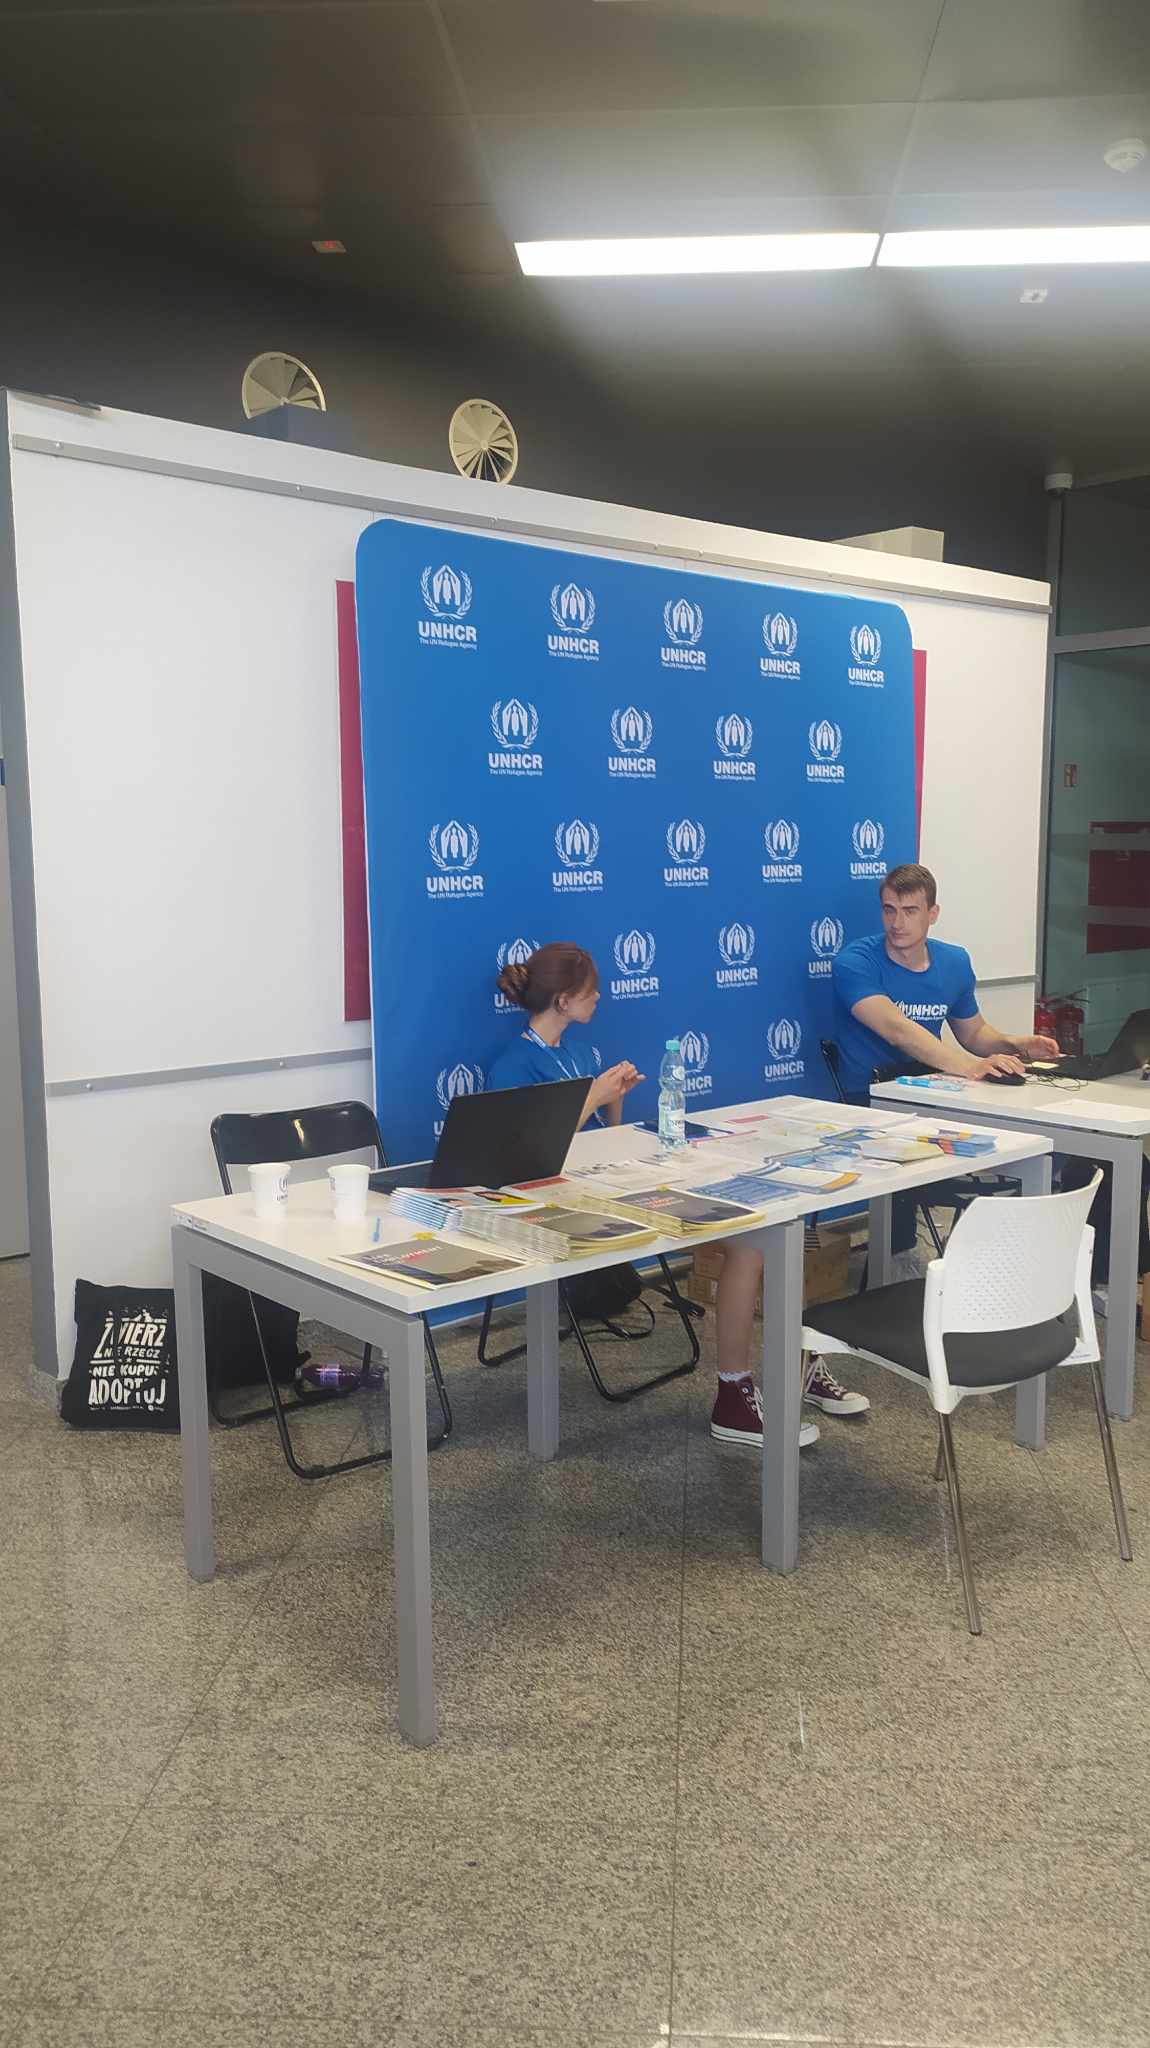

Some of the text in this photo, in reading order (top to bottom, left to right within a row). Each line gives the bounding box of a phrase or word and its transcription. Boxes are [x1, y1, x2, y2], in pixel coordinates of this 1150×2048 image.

[418, 621, 477, 642] UNHCR
[547, 635, 600, 655] UNHCR
[661, 648, 706, 665] UNHCR
[760, 658, 801, 674] UNHCR
[848, 668, 885, 682] UNHCR
[488, 753, 543, 769] UNHCR
[608, 757, 656, 772] UNHCR
[713, 761, 756, 775] UNHCR
[806, 764, 845, 778] UNHCR
[664, 867, 709, 881] UNHCR
[762, 865, 802, 878] UNHCR
[850, 862, 887, 874] UNHCR
[426, 875, 484, 893] UNHCR
[552, 871, 603, 886] UNHCR
[808, 960, 832, 974] UNH
[716, 967, 758, 983] UNHCR
[611, 977, 659, 994] UNHCR
[905, 1003, 948, 1017] UNHCR
[765, 1060, 805, 1078] UNHCR
[682, 1075, 712, 1092] HCR
[124, 1346, 160, 1359] RZECZ
[92, 1364, 116, 1378] NIE
[88, 1377, 166, 1405] ADOPTUJ
